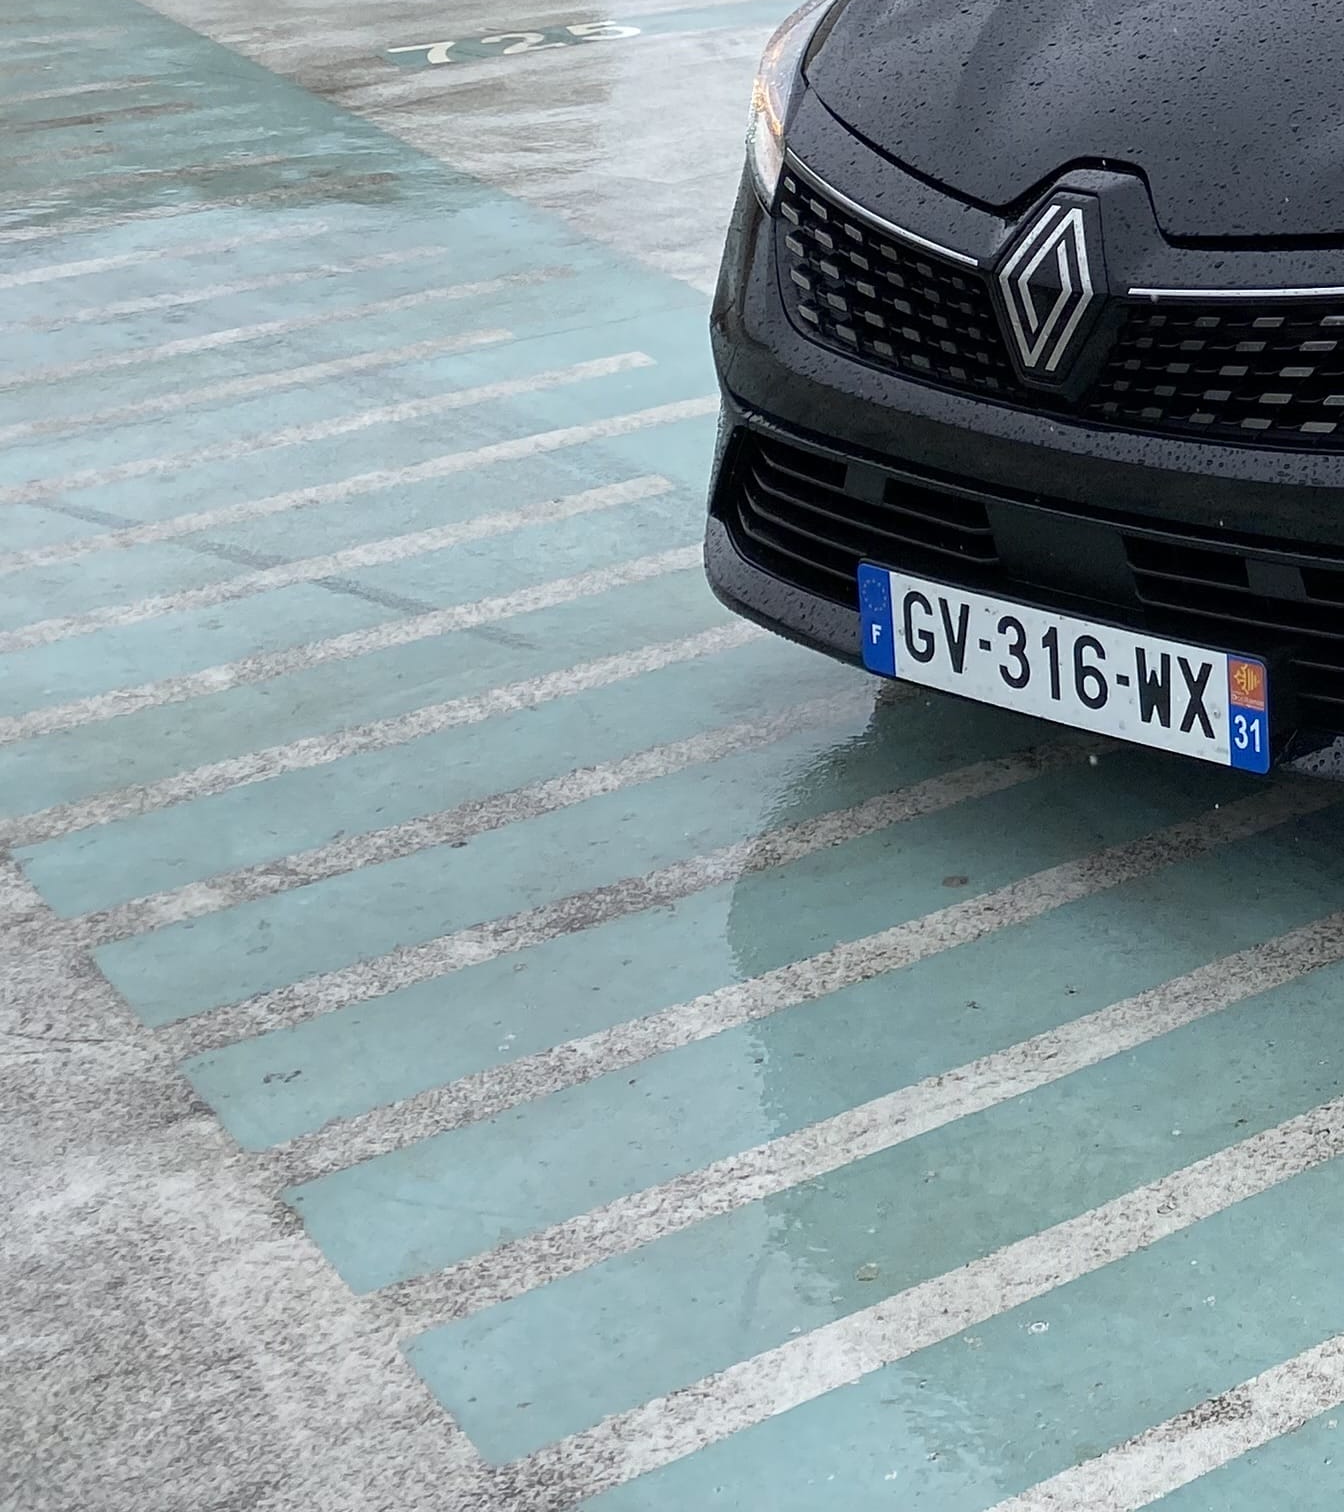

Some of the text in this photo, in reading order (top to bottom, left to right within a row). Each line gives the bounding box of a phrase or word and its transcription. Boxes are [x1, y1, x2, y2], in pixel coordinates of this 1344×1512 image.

[387, 21, 641, 64] 725
[872, 623, 882, 645] F
[903, 590, 1216, 740] GV-316-WX
[1234, 714, 1260, 753] 31
